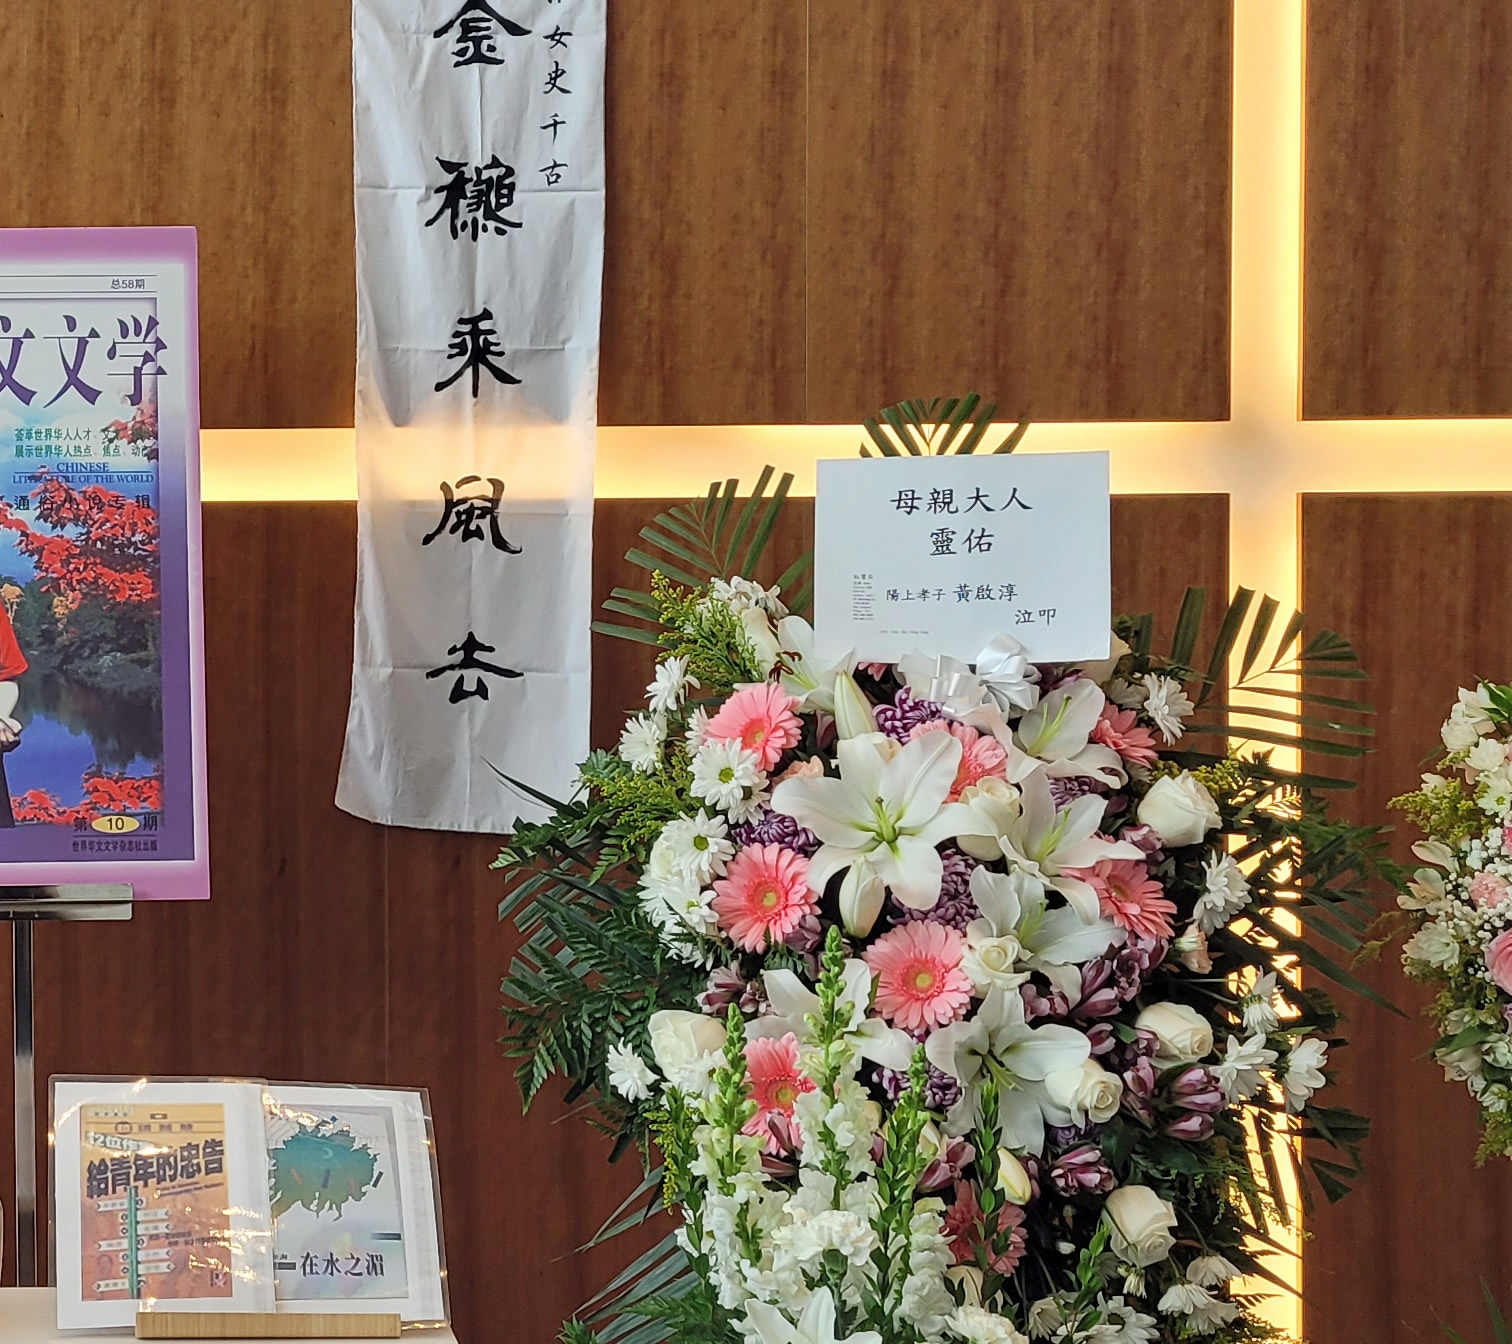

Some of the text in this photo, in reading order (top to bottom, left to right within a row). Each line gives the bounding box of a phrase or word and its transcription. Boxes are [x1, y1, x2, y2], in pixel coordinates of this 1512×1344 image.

[56, 462, 110, 473] CHINESE
[78, 474, 92, 484] OF
[94, 474, 115, 484] THE
[116, 474, 154, 484] WORLD
[889, 487, 1034, 516] 母親大人
[929, 527, 996, 557] 靈佑
[1014, 608, 1058, 626] 泣叩
[86, 1138, 225, 1199] 給青年的忠告
